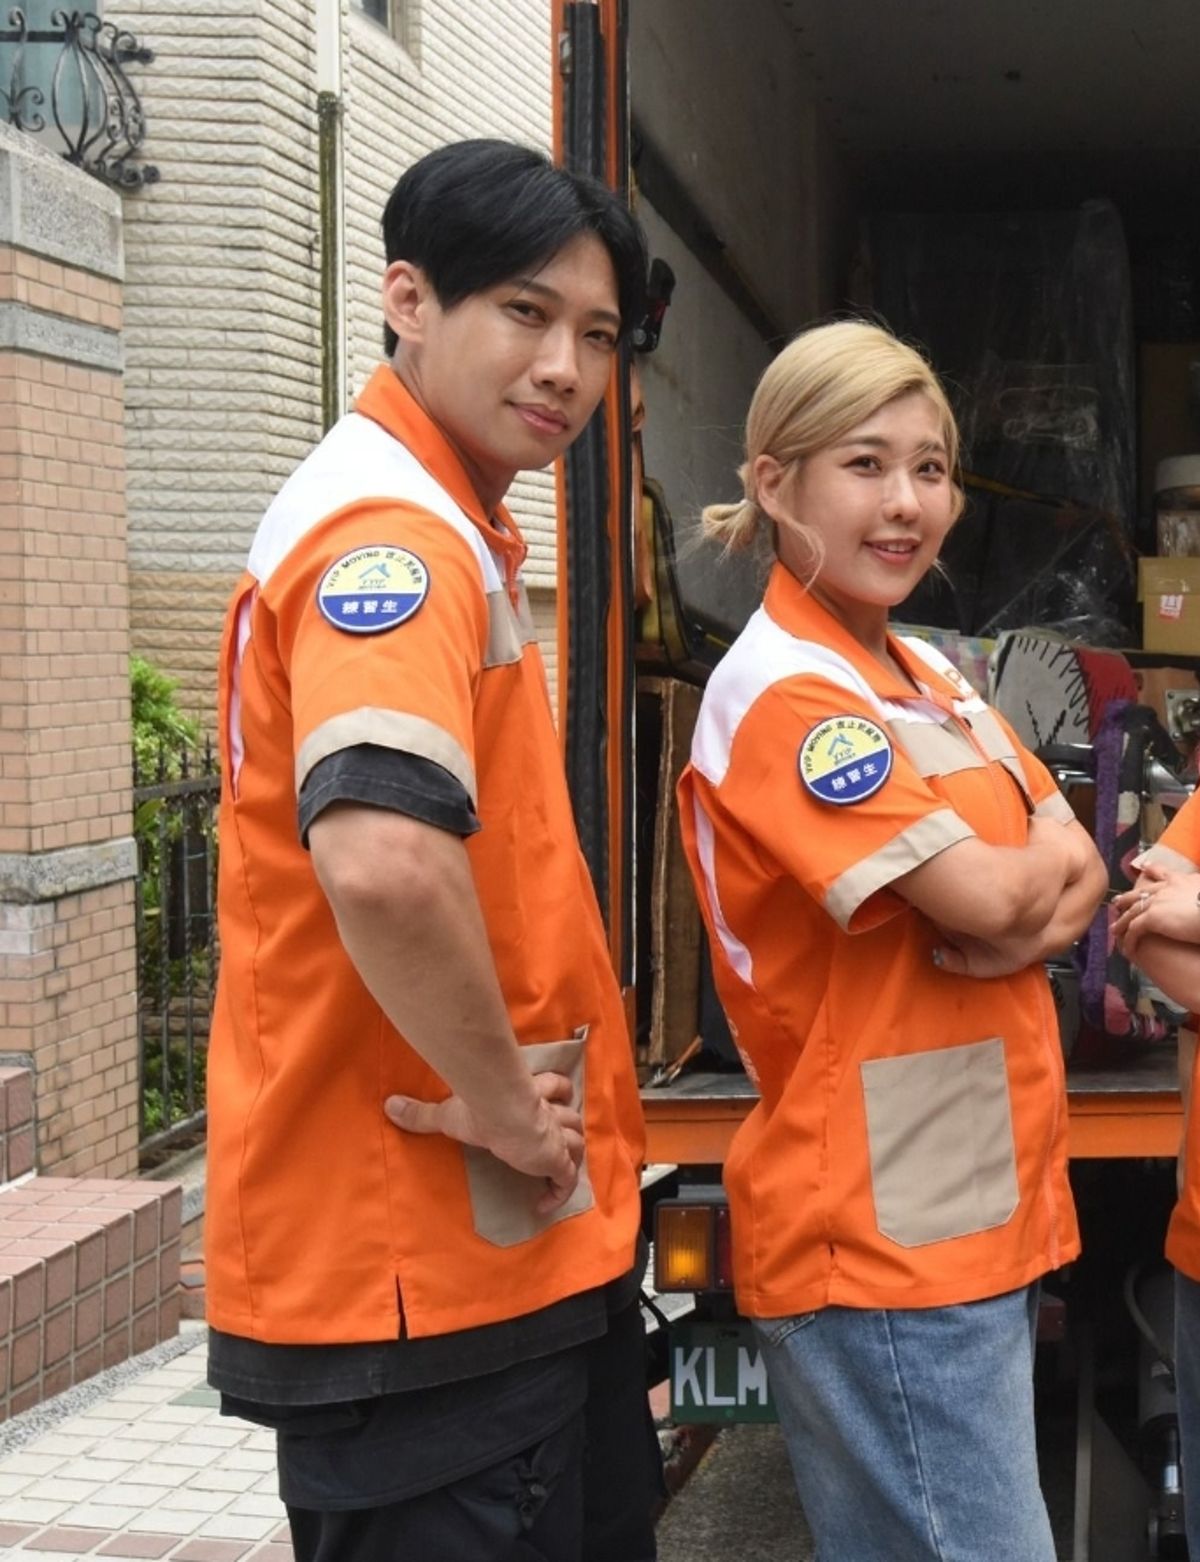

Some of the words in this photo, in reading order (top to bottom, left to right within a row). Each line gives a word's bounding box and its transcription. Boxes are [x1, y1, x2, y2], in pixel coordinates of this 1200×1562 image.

[342, 551, 380, 568] MOVING
[342, 600, 398, 615] 練習生
[808, 725, 832, 752] MOVING
[831, 763, 878, 791] 練習生
[675, 1347, 768, 1406] KLM
